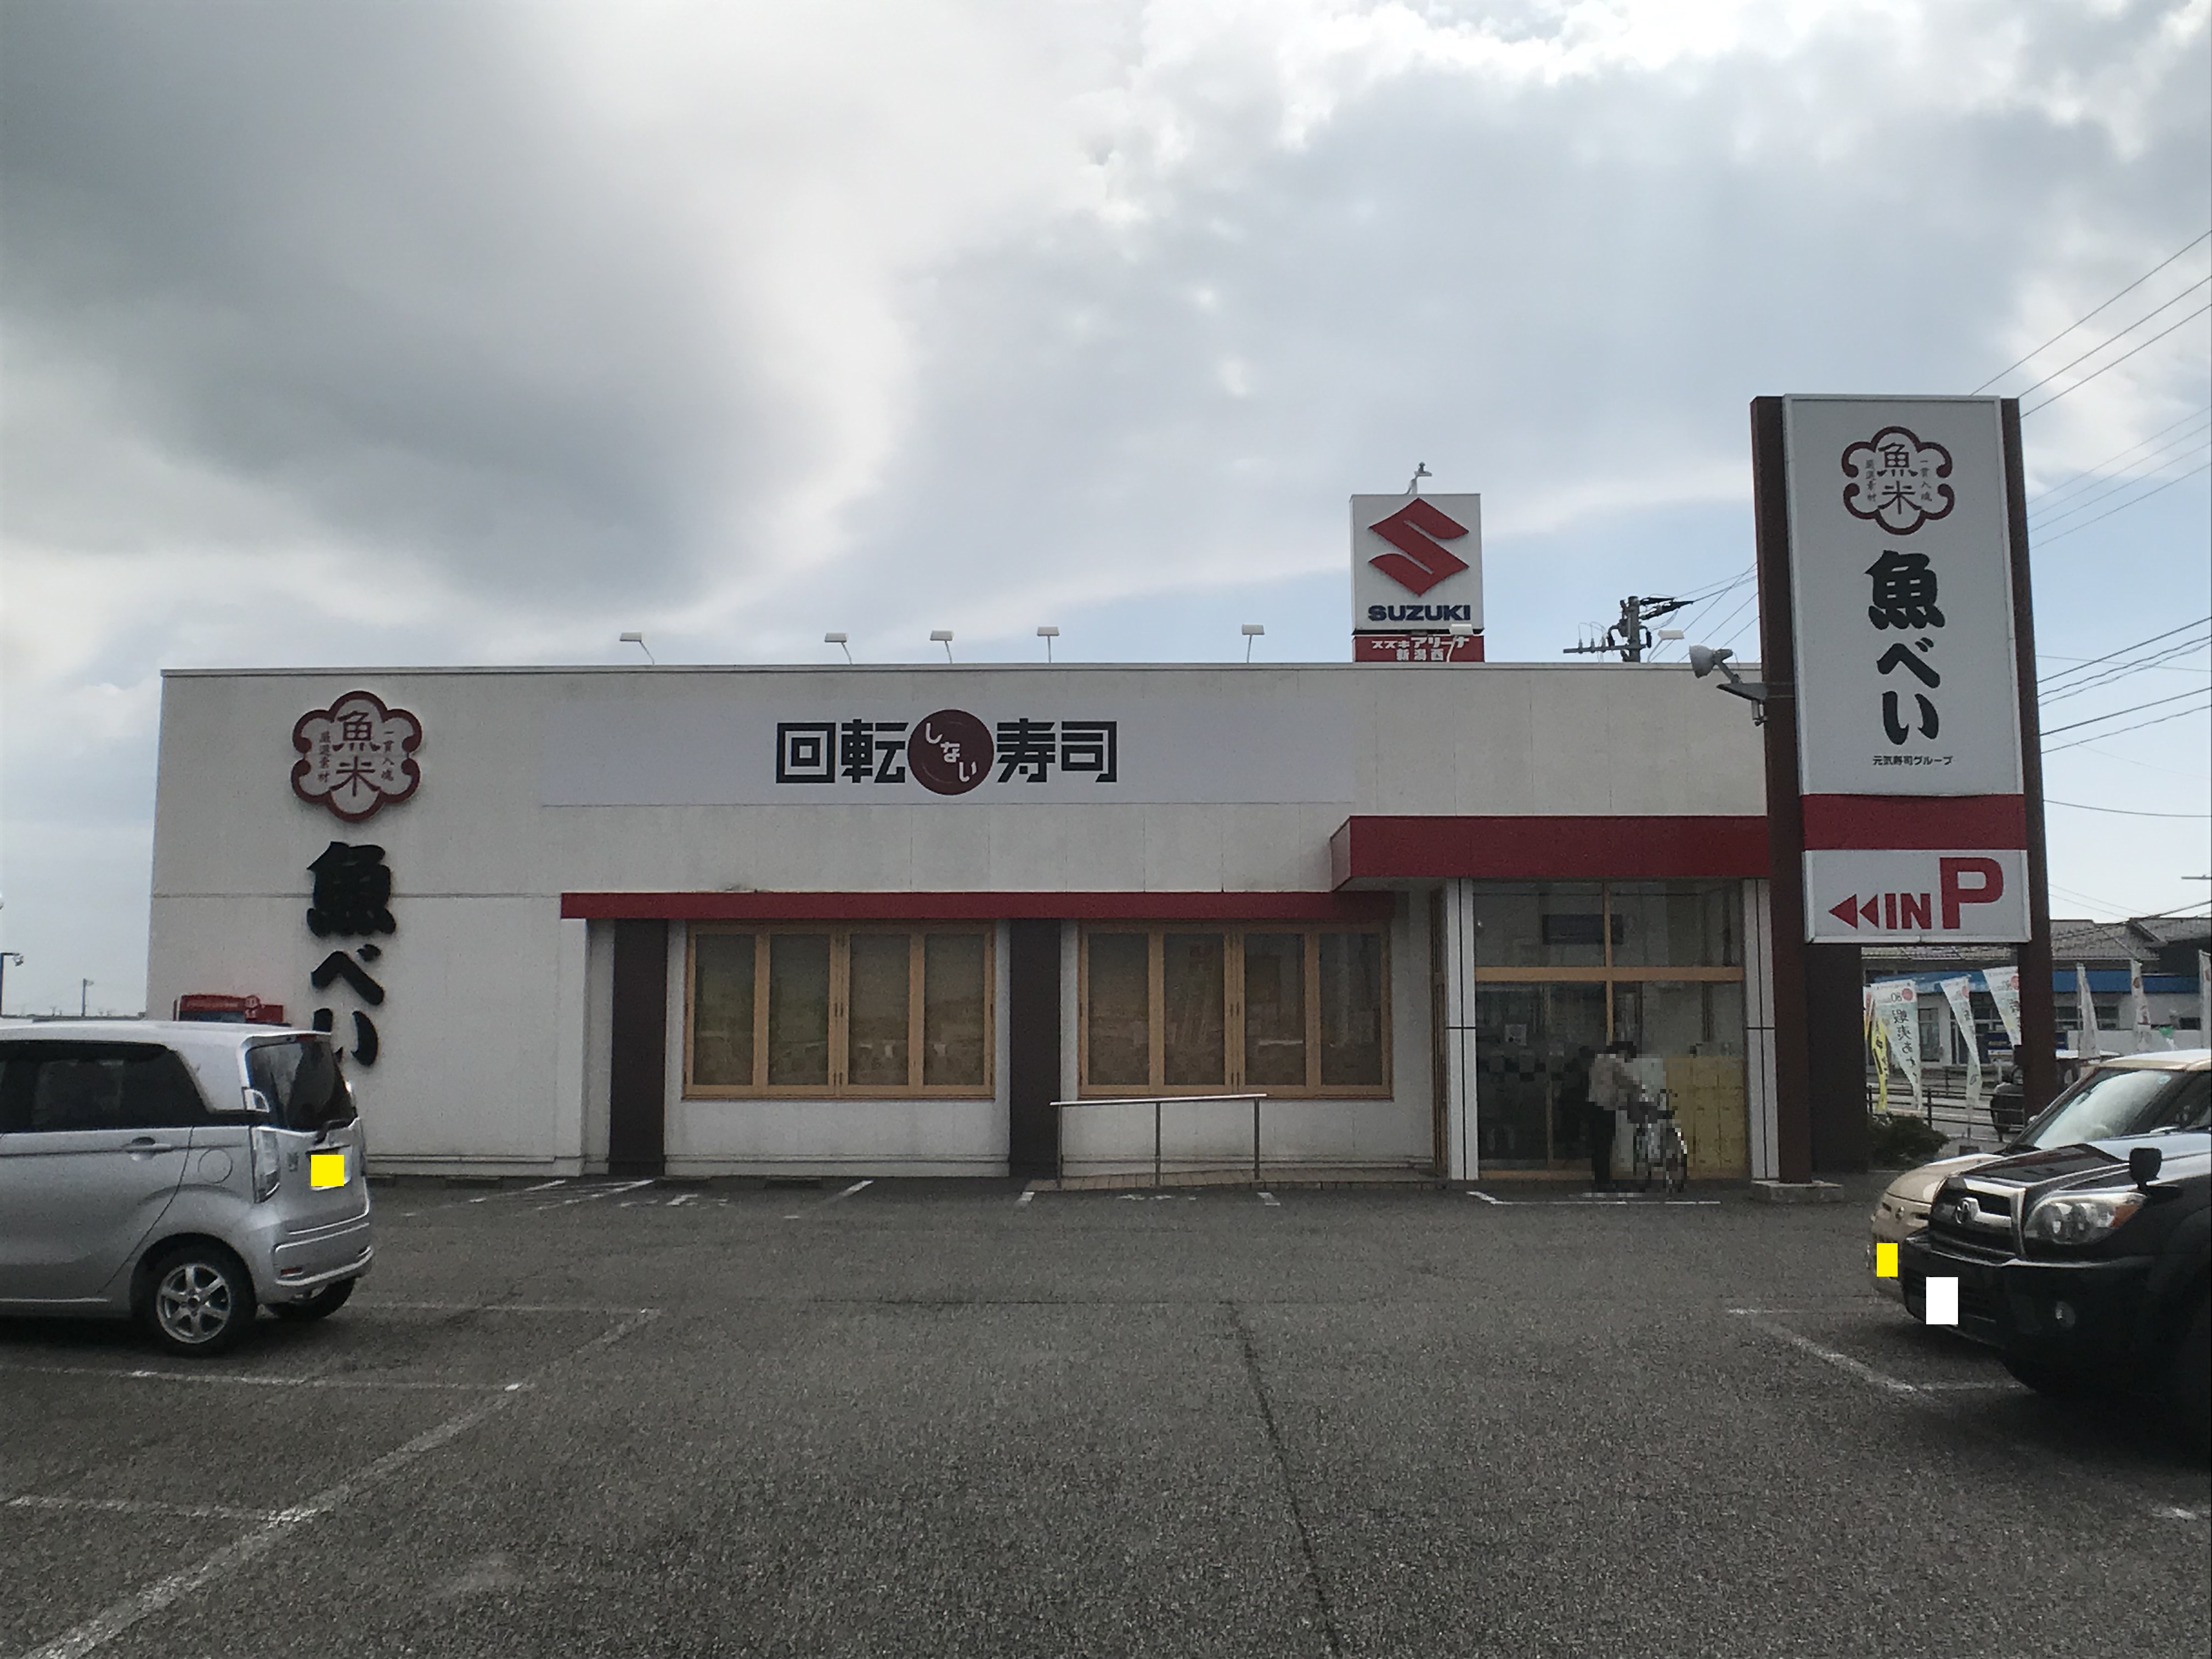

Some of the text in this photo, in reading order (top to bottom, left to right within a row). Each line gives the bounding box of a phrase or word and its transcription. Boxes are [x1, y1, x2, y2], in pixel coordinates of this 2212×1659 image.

[1368, 605, 1471, 620] SUZUKI
[1372, 637, 1470, 649] スズキアリーナ
[1864, 550, 1945, 745] 魚べい
[776, 718, 1117, 783] 回転 しない 寿司
[1872, 755, 1953, 766] 元気寿司グループ
[1884, 857, 2004, 929] IN P
